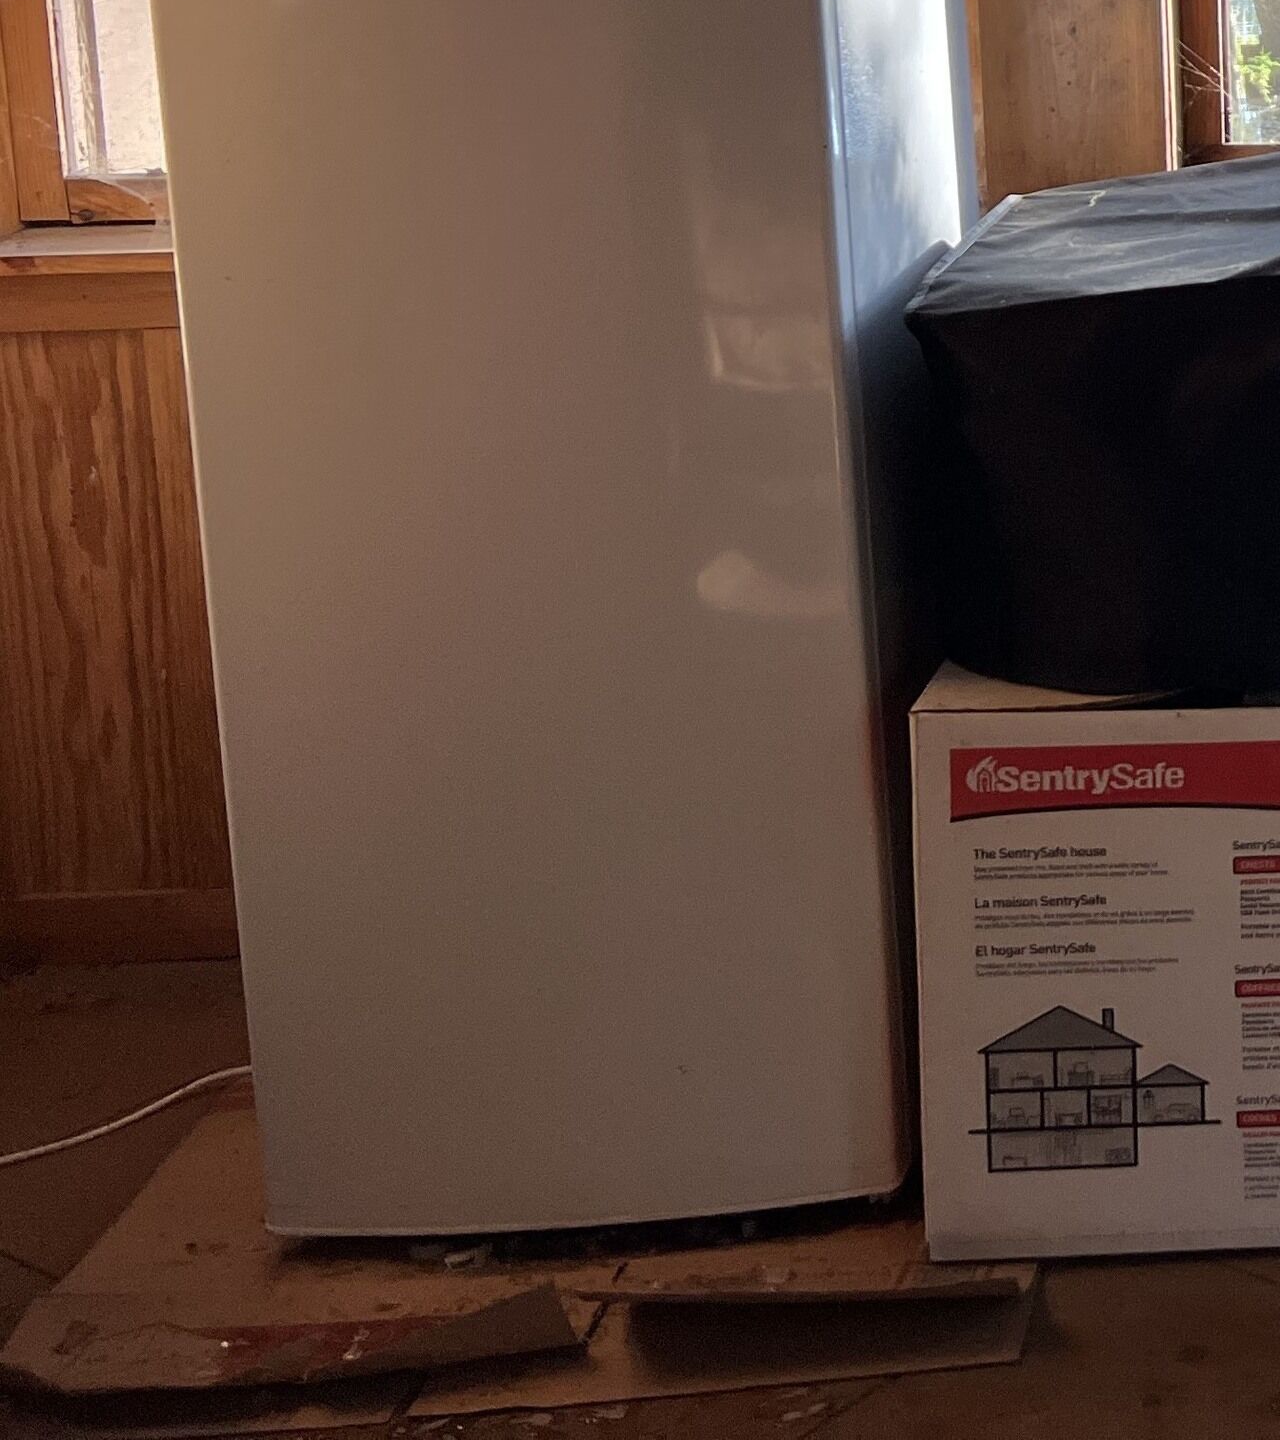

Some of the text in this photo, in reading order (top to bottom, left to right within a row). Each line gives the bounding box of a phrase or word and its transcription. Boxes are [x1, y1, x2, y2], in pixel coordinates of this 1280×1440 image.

[996, 762, 1185, 796] SentrySafe
[973, 846, 1107, 861] The SentrySafe house
[974, 894, 1107, 909] La maison SentrySafe
[975, 942, 1097, 958] El hogar SentrySafe
